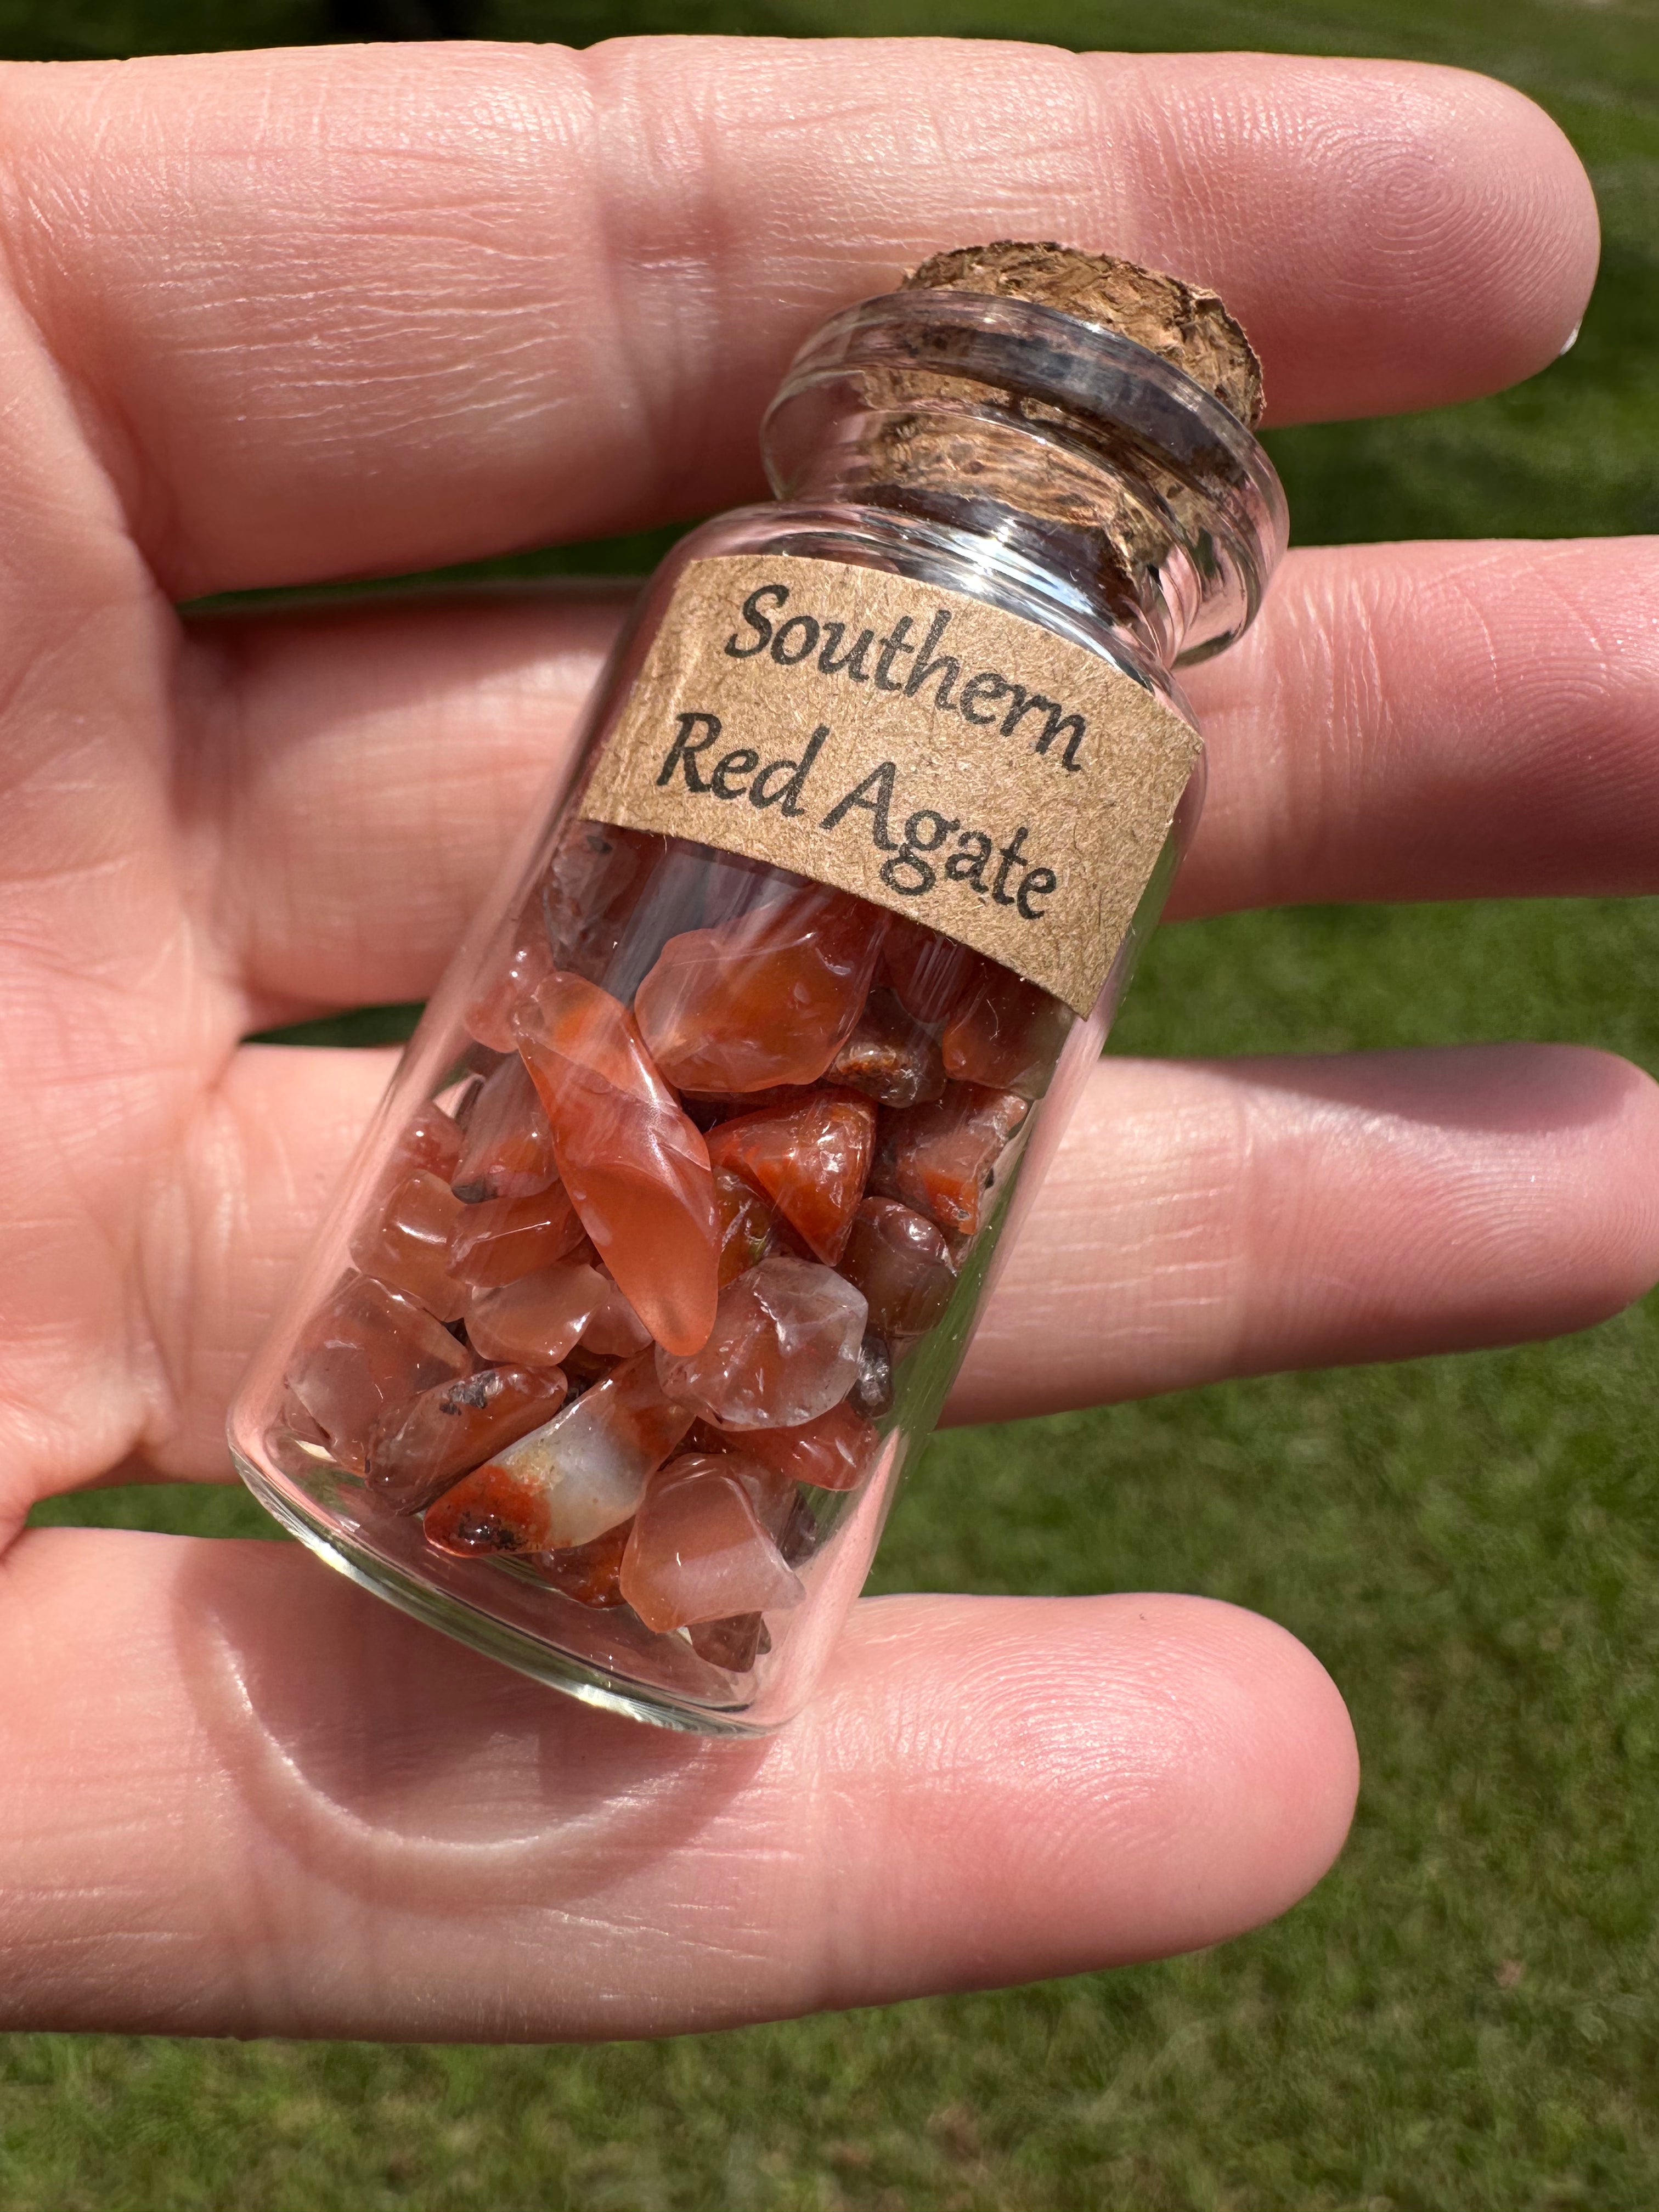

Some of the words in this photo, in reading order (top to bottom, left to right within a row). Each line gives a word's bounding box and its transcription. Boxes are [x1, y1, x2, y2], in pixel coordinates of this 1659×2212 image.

[724, 584, 1089, 772] Southern
[656, 712, 830, 819] Red
[818, 761, 1058, 921] Agate
